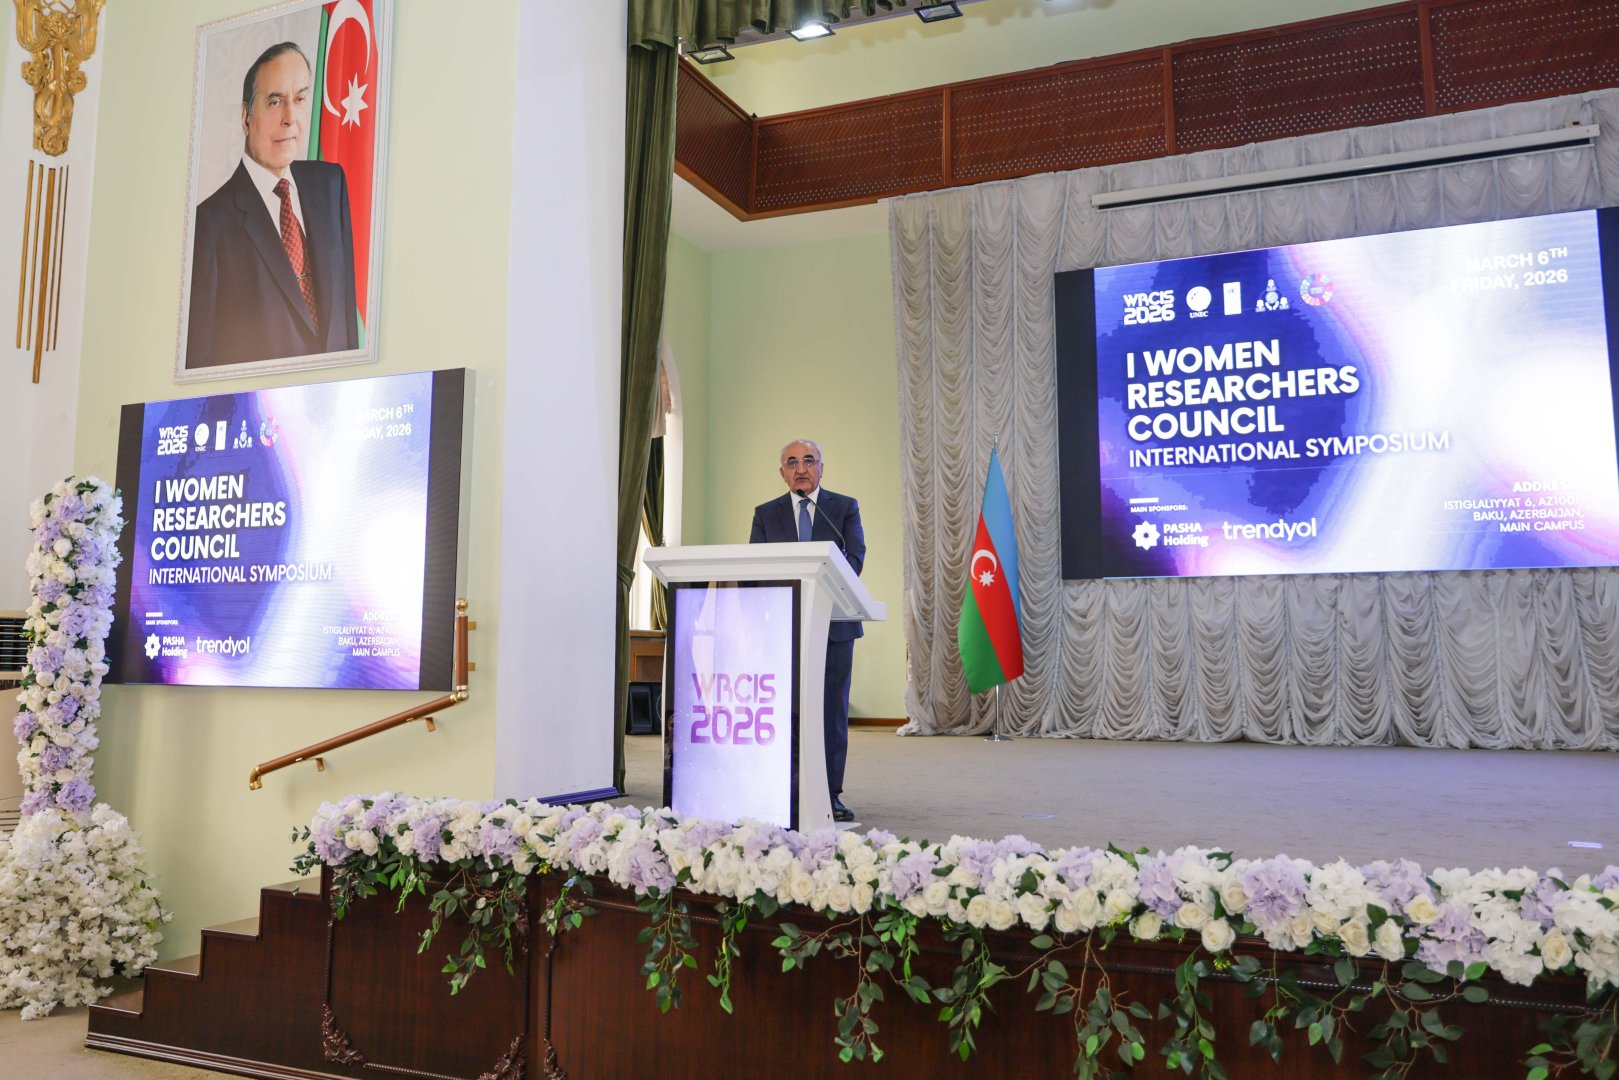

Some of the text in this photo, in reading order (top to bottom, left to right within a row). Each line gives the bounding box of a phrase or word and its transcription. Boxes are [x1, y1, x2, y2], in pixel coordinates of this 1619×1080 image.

[1466, 247, 1568, 272] MARCH 6TH
[1523, 269, 1568, 286] 2026
[1123, 290, 1174, 307] WRCIS
[1123, 303, 1175, 325] 2026
[1126, 339, 1280, 378] I WOMEN
[1127, 366, 1360, 410] RESEARCHERS
[396, 403, 414, 419] 6TH
[386, 423, 412, 437] 2026
[1127, 405, 1284, 441] COUNCIL
[158, 425, 189, 440] WRCIS
[157, 438, 188, 455] 2026
[1129, 430, 1450, 468] INTERNATIONAL SYMPOSIUM
[154, 474, 244, 503] I WOMEN
[1444, 498, 1521, 510] ISTIGLALIYYAT
[1525, 498, 1536, 508] 6,
[153, 501, 286, 532] RESEARCHERS
[1474, 508, 1584, 522] BAKU, AZERBAIJAN,
[1163, 522, 1202, 534] PASHA
[1222, 518, 1317, 541] trendyol
[1500, 520, 1585, 532] MAIN CAMPUS
[151, 534, 240, 561] COUNCIL
[1163, 535, 1208, 547] Holding
[149, 563, 332, 584] INTERNATIONAL SYMPOSIUM
[162, 636, 185, 645] PASHA
[196, 636, 250, 657] trendyol
[338, 637, 357, 647] BAKU,
[162, 647, 188, 658] Holding
[352, 648, 400, 657] MAIN CAMPUS
[691, 673, 776, 704] WRCIS
[690, 705, 776, 746] 2026
